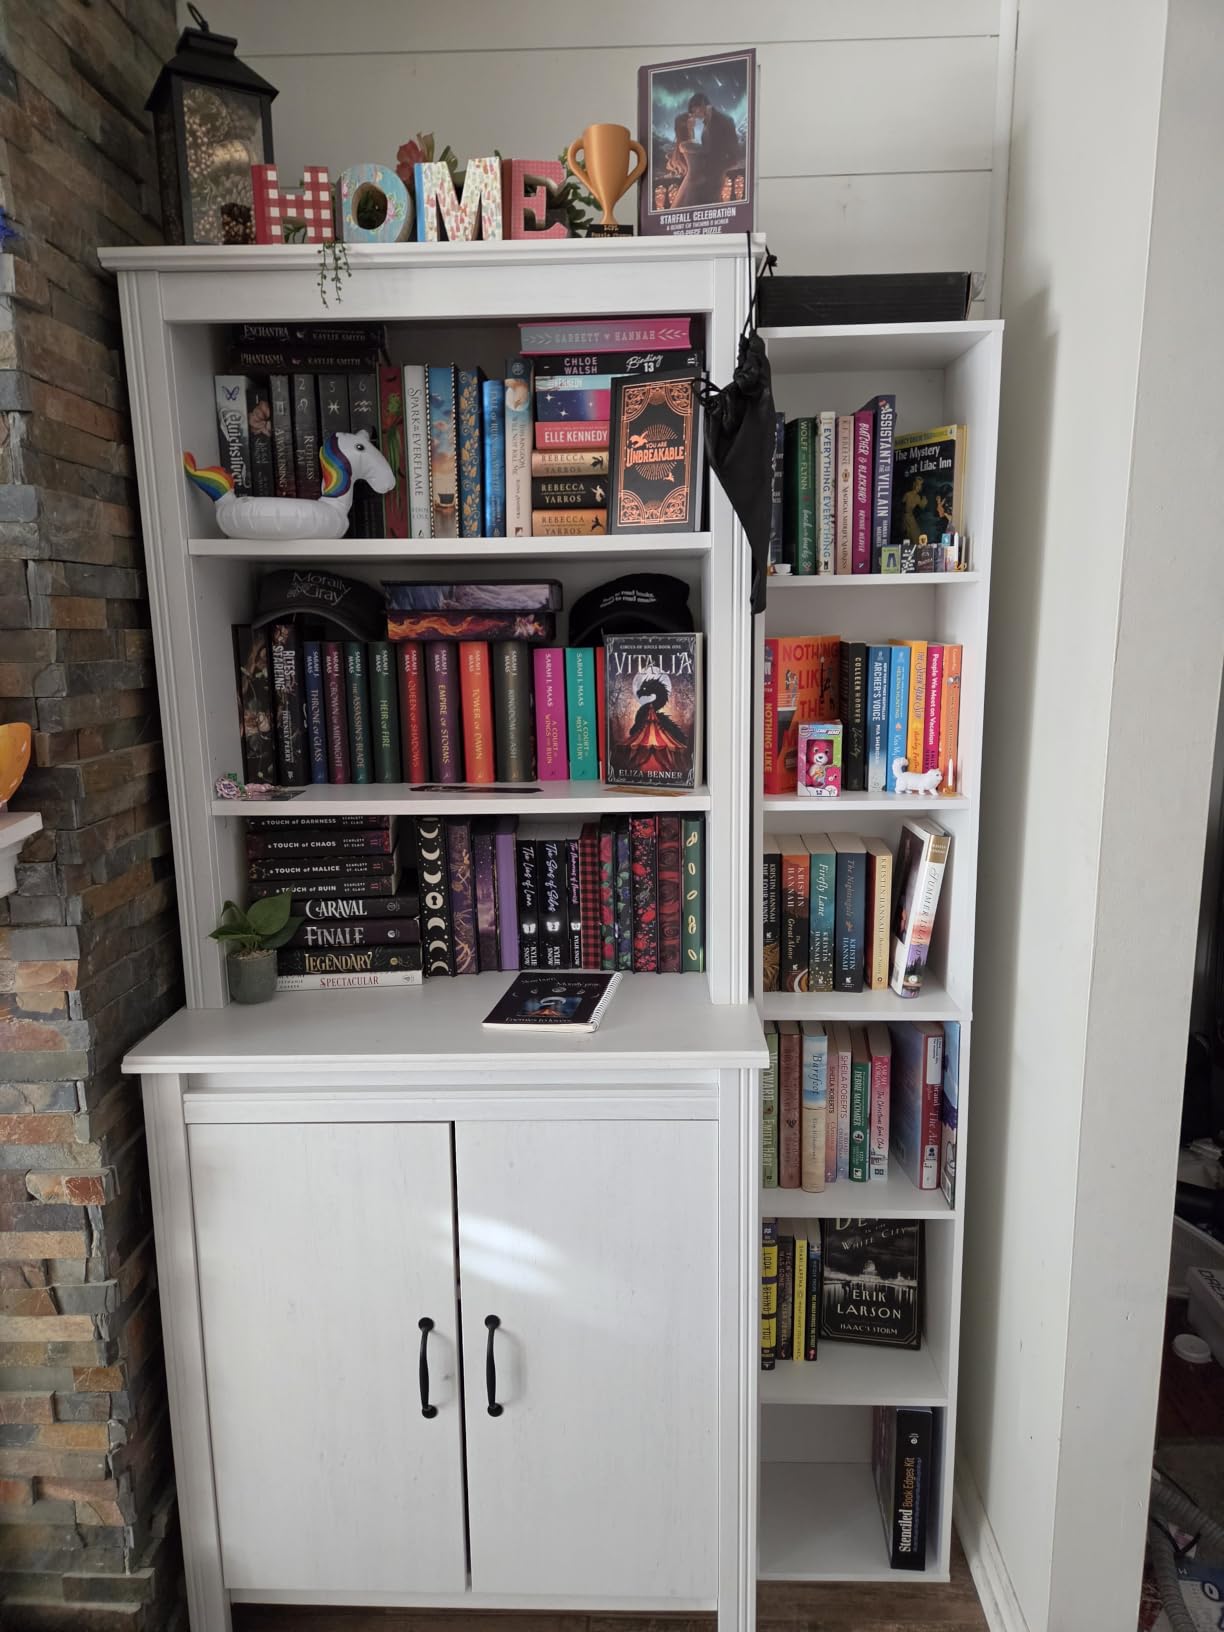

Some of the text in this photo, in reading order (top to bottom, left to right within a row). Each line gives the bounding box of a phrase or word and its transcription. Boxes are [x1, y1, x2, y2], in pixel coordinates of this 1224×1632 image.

[251, 156, 568, 245] HOME
[660, 207, 736, 225] STARFALL CELEBRATION
[243, 325, 289, 341] ENCHANTRA
[555, 330, 657, 344] GARRETT HANNAH
[241, 353, 284, 366] PHANTASMA
[564, 357, 598, 366] CHLOE
[564, 366, 598, 375] WALSH
[626, 354, 663, 372] Binding
[643, 363, 655, 373] 13
[406, 388, 422, 427] SPARK
[219, 408, 252, 488] Quicksilver
[544, 431, 607, 443] ELLE KENNEDY
[275, 428, 287, 489] AWAKENING
[303, 435, 315, 481] RUTHLESS
[412, 433, 424, 498] EVERFLAME
[541, 454, 585, 462] REBECCA
[626, 446, 685, 467] UNBREAKABLE
[800, 421, 808, 490] WOLFF FLYNN
[857, 423, 871, 504] BUTCHER BLACKBIRD
[877, 406, 893, 517] ASSISTANT VILLAIN
[895, 446, 941, 461] The Mystery
[910, 456, 952, 474] at Lilac Inn
[541, 483, 585, 491] REBECCA
[545, 494, 582, 503] YARROS
[823, 428, 833, 558] EVERYTHING EVERYTHING
[842, 486, 850, 513] MAGICAL
[541, 515, 585, 524] REBECCA
[545, 526, 582, 535] YARROS
[293, 572, 352, 595] Morally
[303, 584, 343, 606] Gray
[284, 650, 296, 676] RITES
[614, 651, 693, 676] VITALIA
[783, 642, 840, 661] NOTHING
[272, 645, 285, 690] STARLING
[931, 653, 940, 677] People
[576, 653, 585, 707] SARAH MAAS
[872, 662, 882, 721] ARCHER'S VOICE
[931, 678, 938, 688] We
[799, 699, 825, 718] THE
[930, 708, 936, 717] on
[311, 689, 322, 762] THRONE GLASS
[330, 681, 343, 768] CROWN MIDNIGHT
[353, 695, 365, 768] ASSASSIN'S BLADE
[380, 700, 390, 749] HEIR FIRE
[407, 680, 420, 768] QUEEN SHADOWS
[438, 684, 450, 765] EMPIRE STORMS
[472, 688, 483, 760] TOWER DAWN
[507, 689, 518, 759] KINGDOM ASH
[928, 717, 936, 745] Vacation
[551, 727, 559, 750] COURT
[764, 703, 773, 772] NOTHING LIKE
[849, 727, 862, 759] Verity
[283, 740, 291, 763] PERRY
[618, 769, 683, 779] ELIZA BENNER
[524, 862, 535, 879] Lies
[546, 859, 558, 879] Sins
[787, 867, 795, 907] HANNAH
[816, 863, 828, 917] Firefly Lane
[844, 875, 854, 918] Nightingale
[921, 867, 940, 916] SUMMER
[305, 899, 368, 920] CARAVAL
[304, 926, 365, 946] FINALE
[787, 918, 795, 960] Great Alone
[914, 919, 927, 956] ISLAND
[304, 951, 373, 974] LEGENDARY
[553, 946, 561, 966] KYLIE
[320, 975, 379, 988] SPECTACULAR
[808, 1054, 824, 1096] Barefoot
[840, 1055, 848, 1081] SHEILA
[840, 1083, 848, 1119] ROBERTS
[853, 1070, 862, 1126] DEBBIE MACOMBER
[876, 1138, 884, 1150] Club
[763, 1252, 772, 1270] LOOK
[763, 1286, 772, 1312] BEHIND
[852, 1289, 886, 1303] ERIK
[837, 1303, 902, 1320] LARSON
[762, 1327, 771, 1339] YOU
[898, 1457, 915, 1553] Stenciled Book Edges Kit
